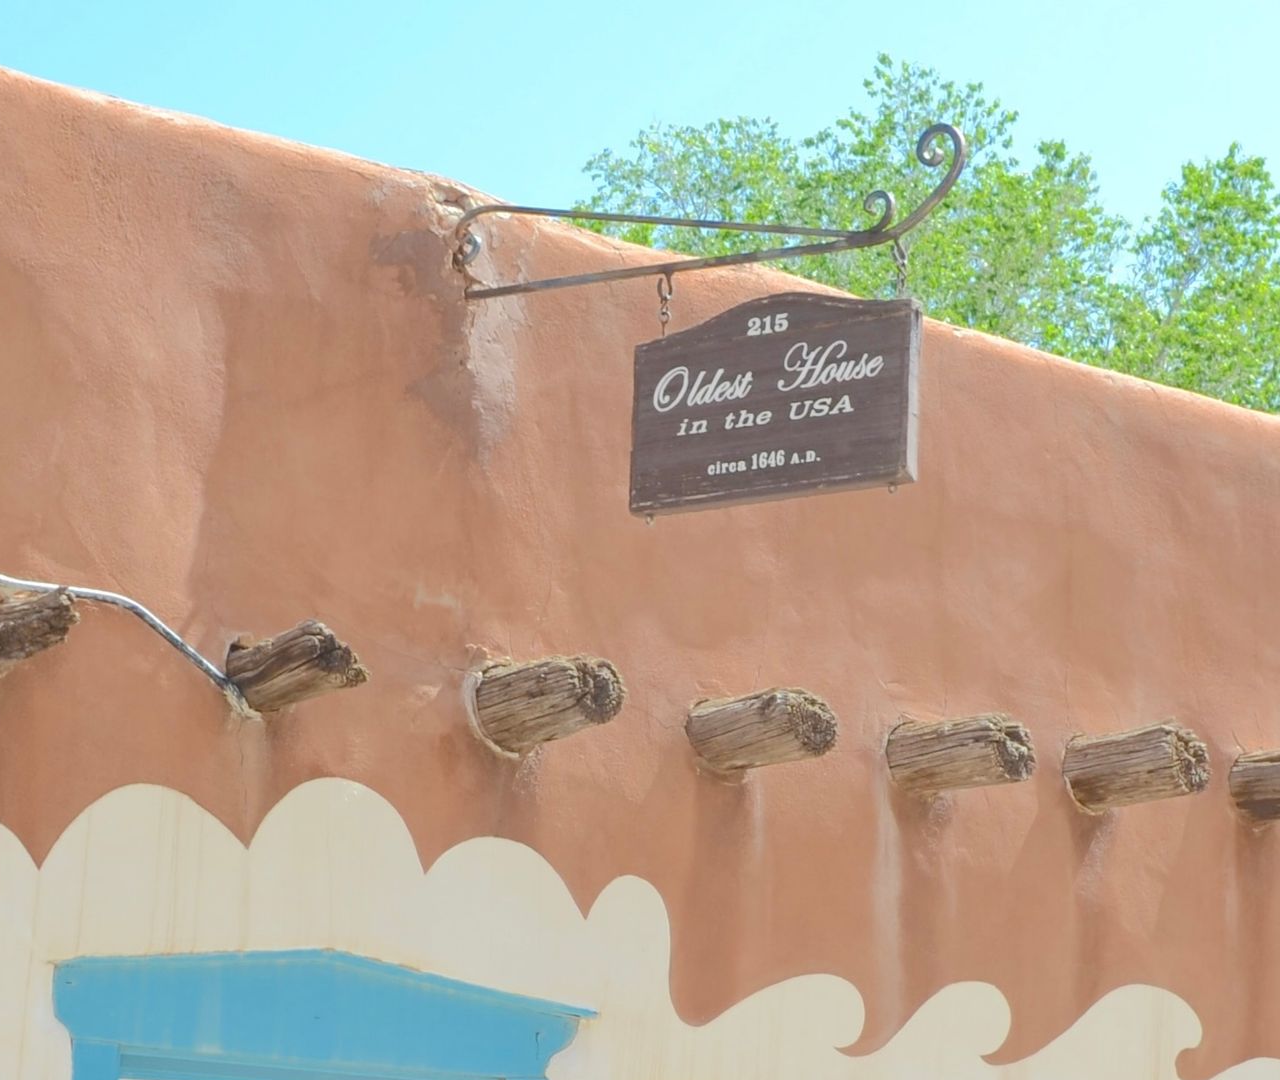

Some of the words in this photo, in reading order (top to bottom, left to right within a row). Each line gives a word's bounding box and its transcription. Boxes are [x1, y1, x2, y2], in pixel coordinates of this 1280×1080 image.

[746, 312, 789, 337] 215
[653, 365, 754, 413] Oldest
[776, 339, 885, 392] House
[676, 418, 708, 437] in
[723, 409, 773, 431] the
[788, 394, 855, 420] USA
[707, 457, 747, 476] circa
[751, 449, 786, 471] 1646
